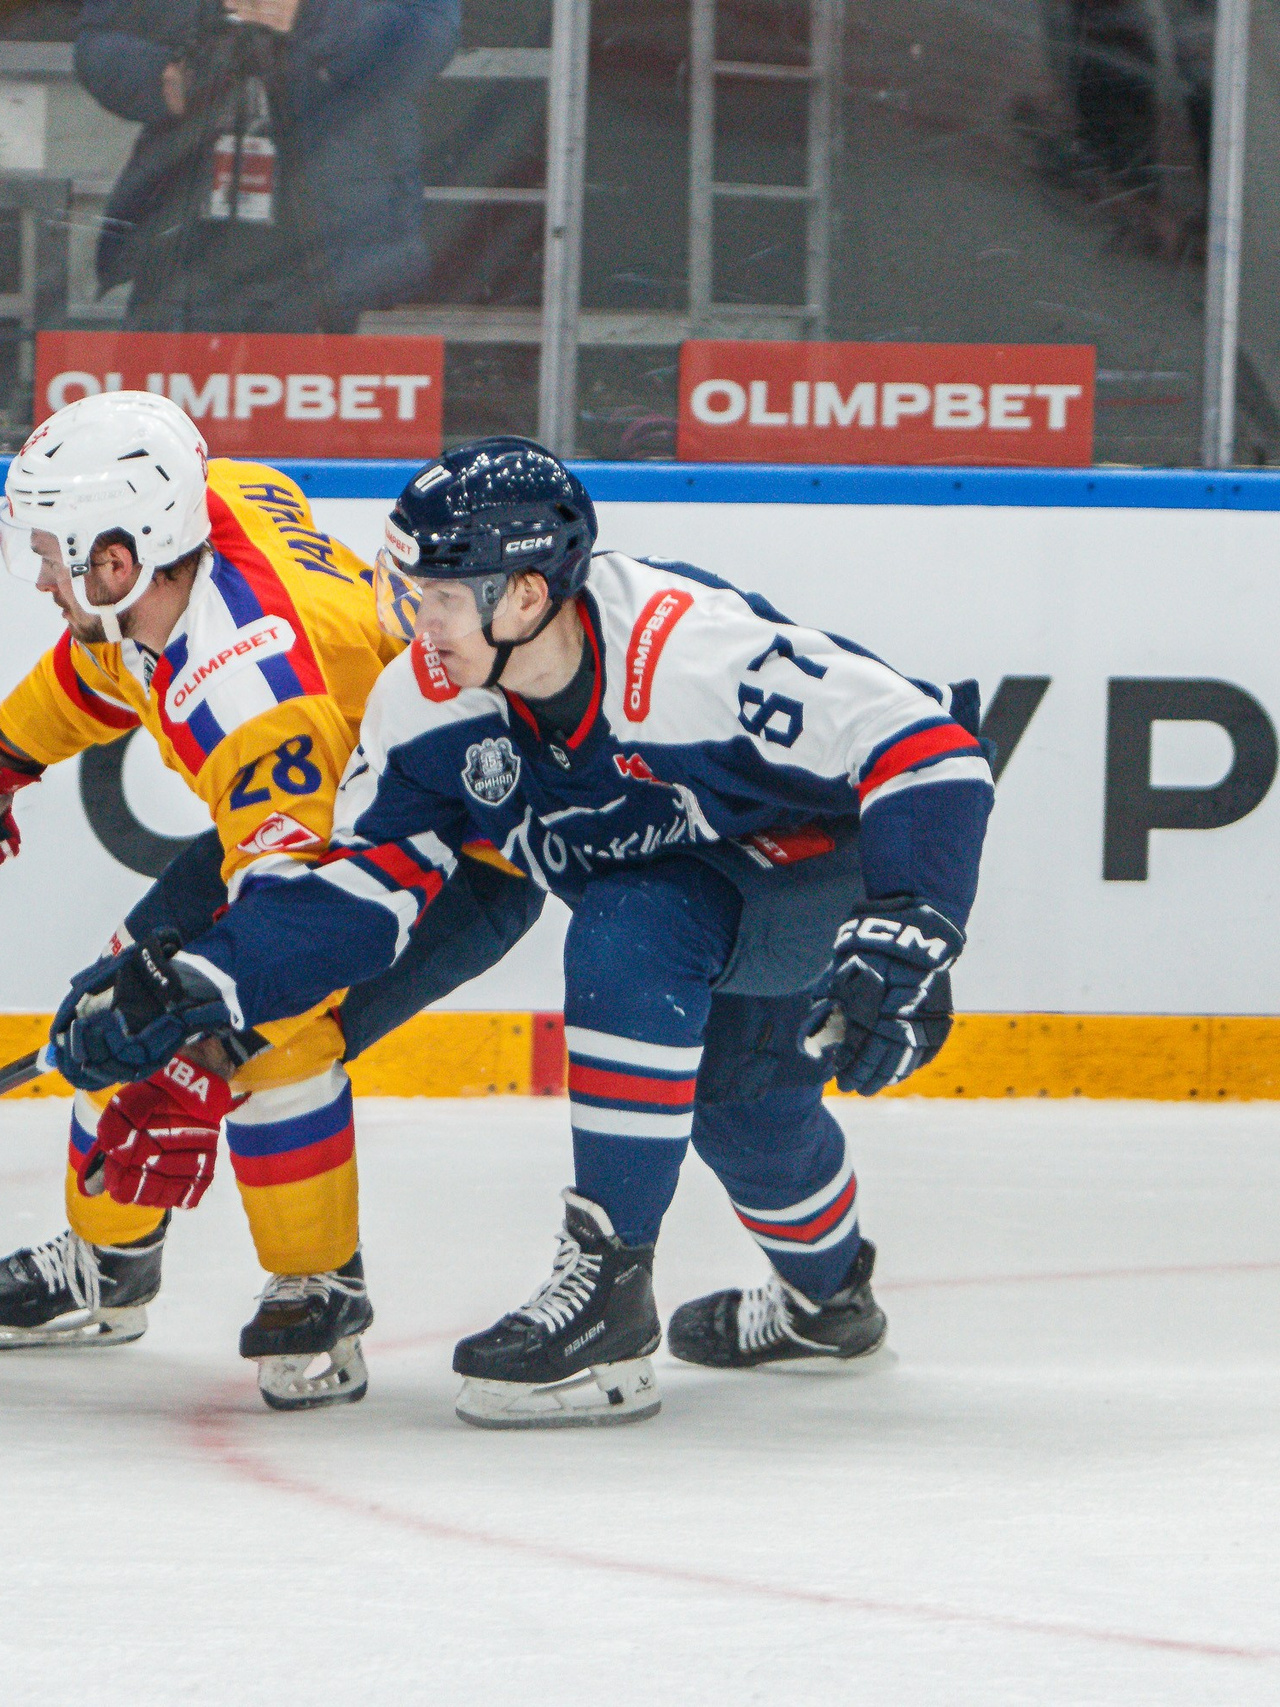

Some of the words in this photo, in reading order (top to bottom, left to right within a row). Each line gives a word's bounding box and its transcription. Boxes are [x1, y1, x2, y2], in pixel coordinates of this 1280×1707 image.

[690, 378, 1082, 432] OLIMPBET
[505, 535, 553, 553] CCM
[173, 626, 279, 708] OLIMPBET
[631, 594, 680, 709] OLIMPBET
[738, 632, 828, 749] 87
[230, 734, 322, 812] 28
[833, 917, 948, 960] CCM
